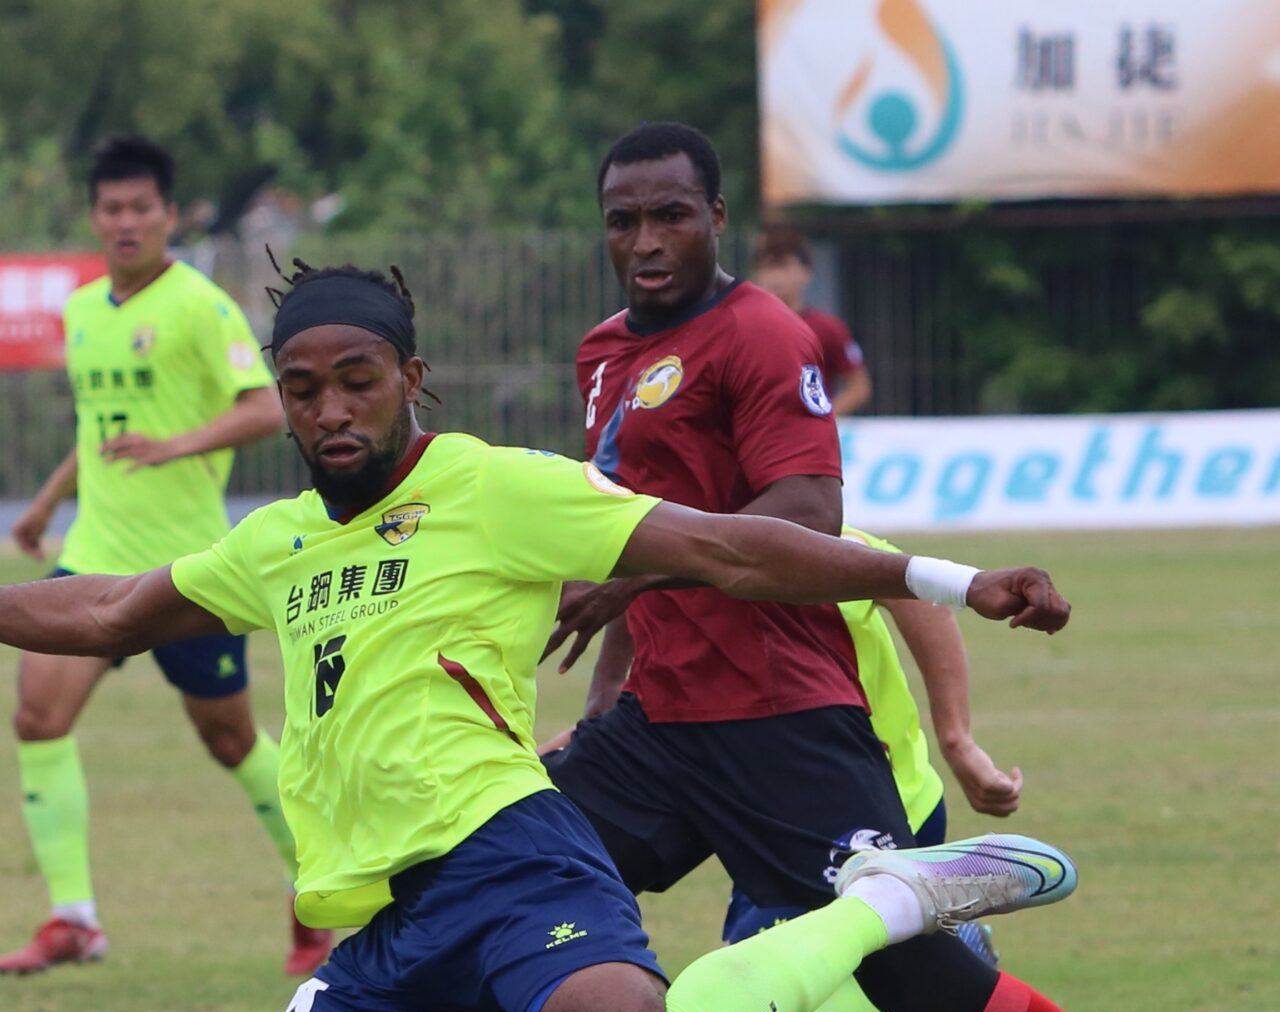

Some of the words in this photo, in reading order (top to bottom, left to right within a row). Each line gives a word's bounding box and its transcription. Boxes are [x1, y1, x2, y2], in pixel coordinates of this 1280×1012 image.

[286, 559, 410, 626] 台鋼集團
[320, 609, 346, 633] STEEL
[350, 600, 399, 620] GROUP
[545, 930, 588, 949] KELME
